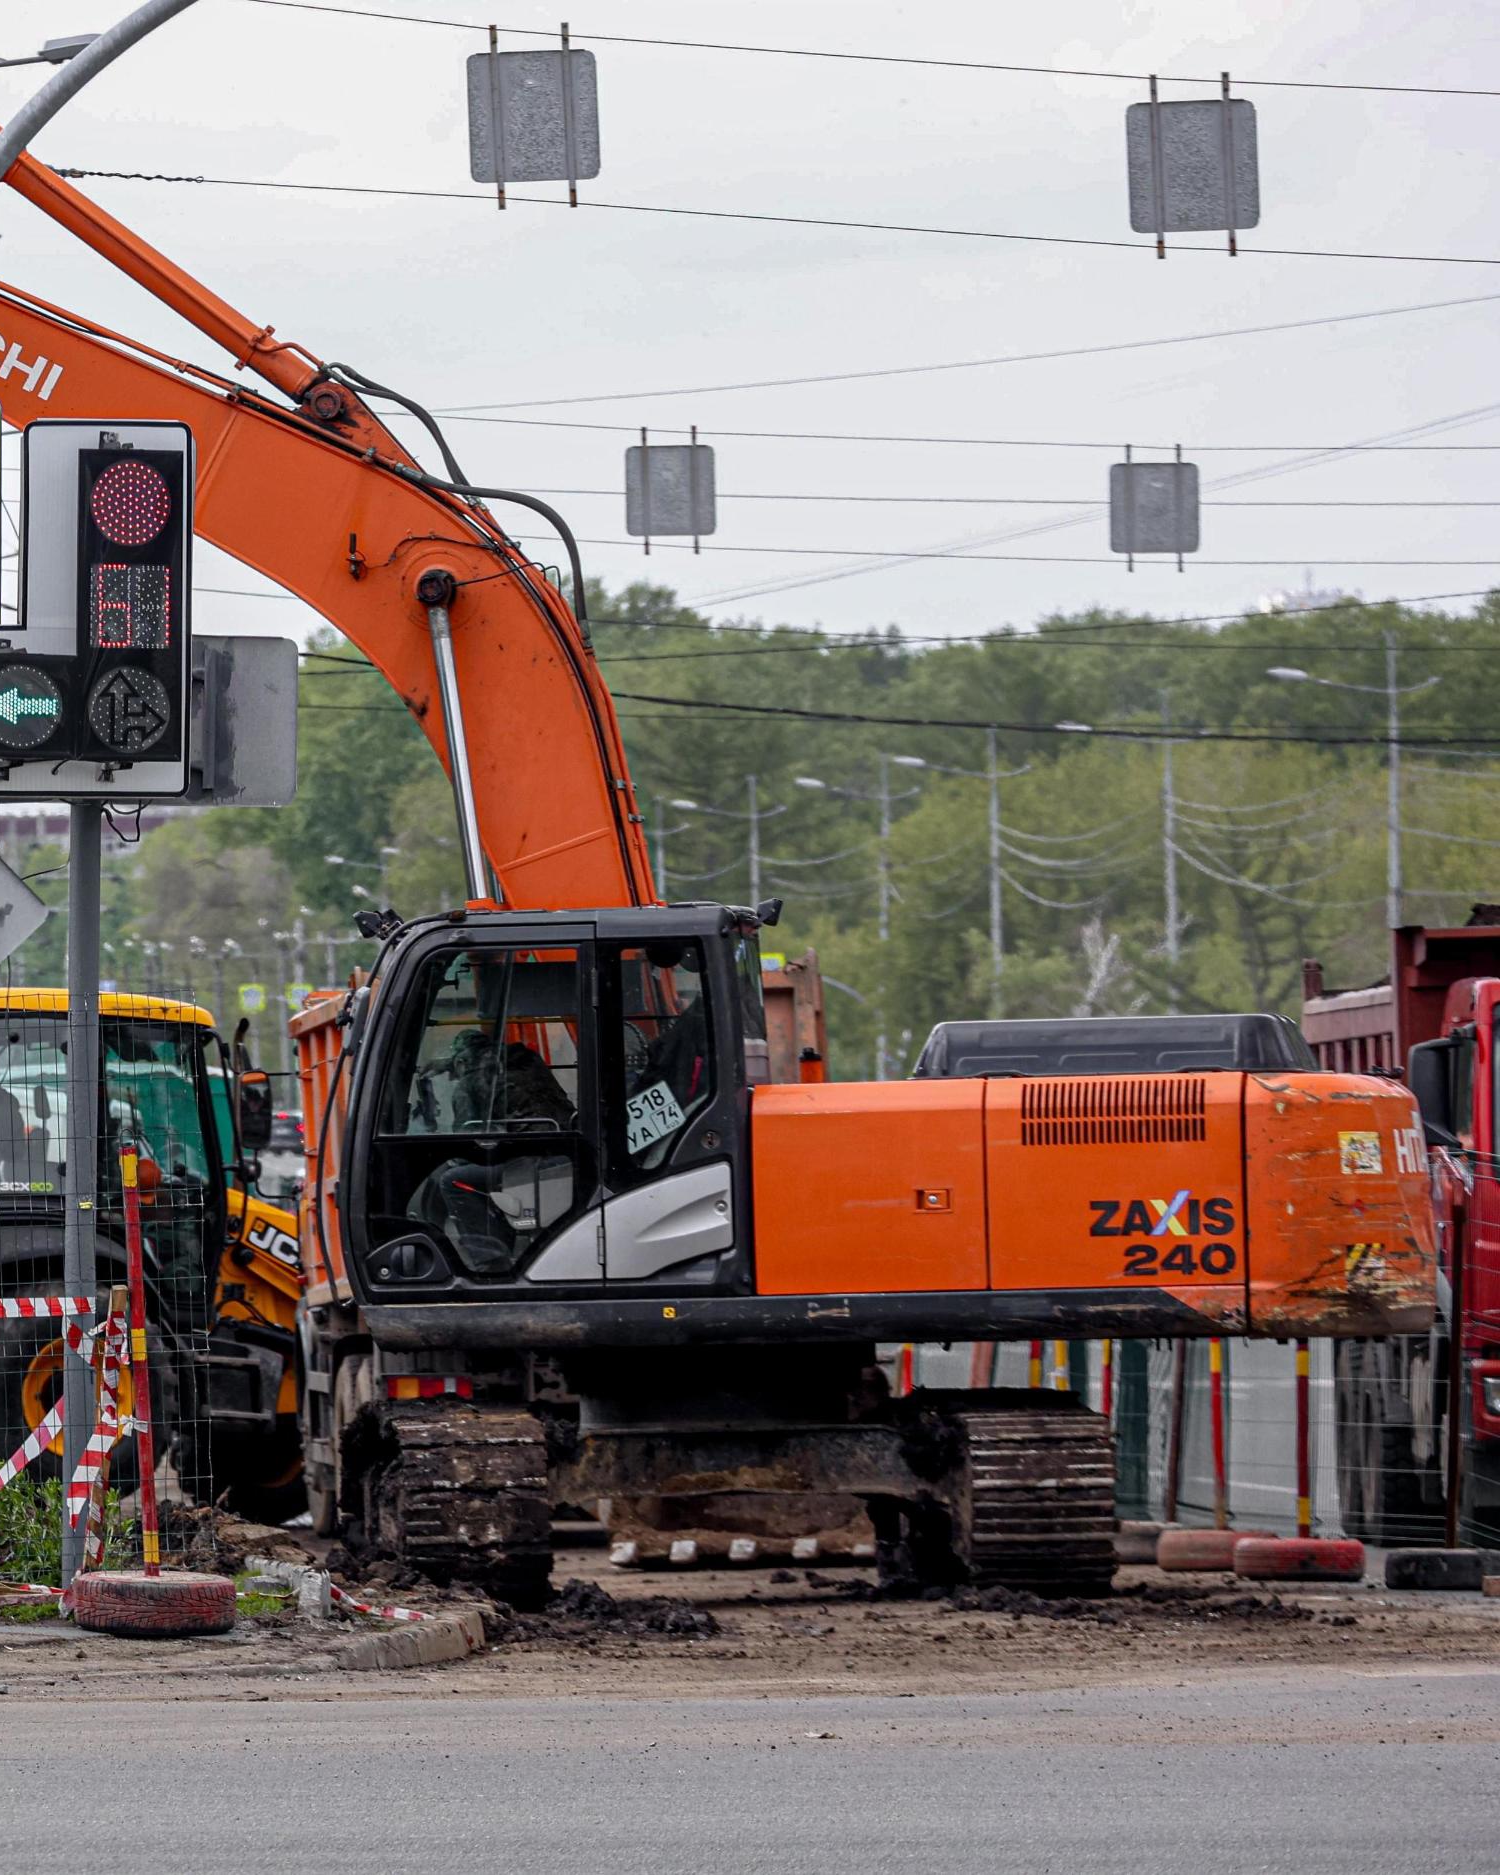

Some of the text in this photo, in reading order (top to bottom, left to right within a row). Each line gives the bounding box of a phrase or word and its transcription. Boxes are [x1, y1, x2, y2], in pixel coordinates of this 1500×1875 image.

[1089, 1189, 1236, 1237] ZAXIS
[248, 1226, 300, 1268] JC
[1123, 1243, 1237, 1277] 240
